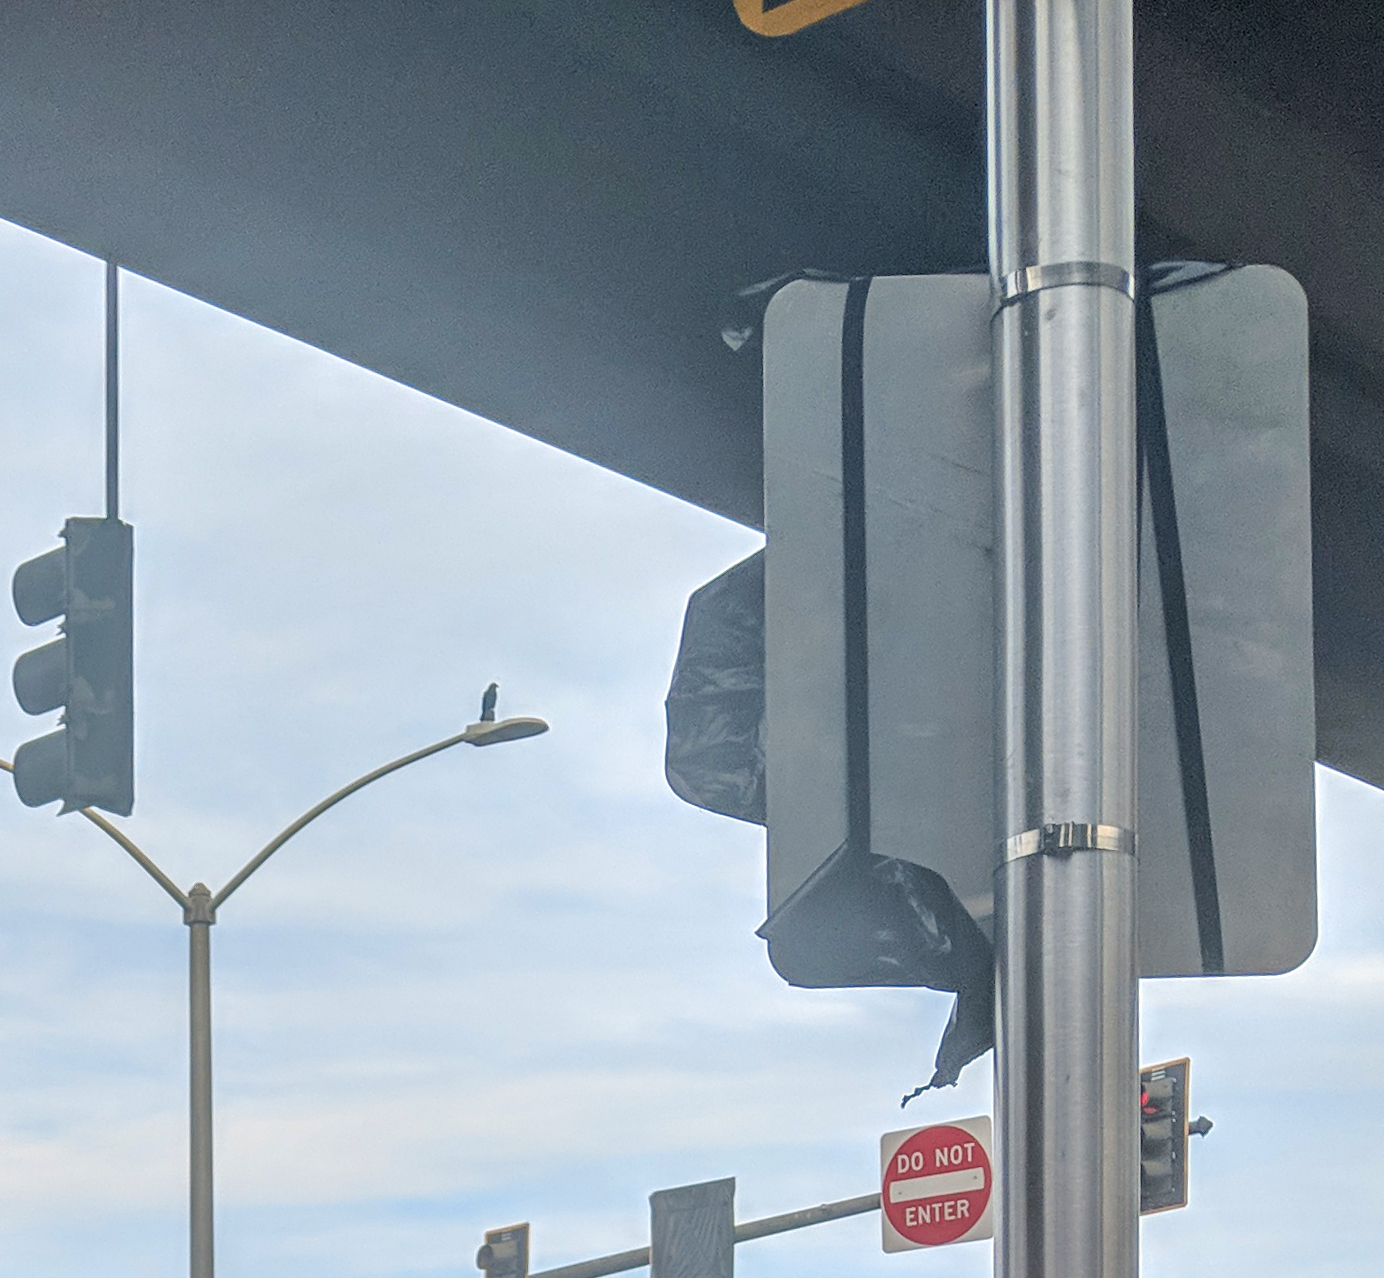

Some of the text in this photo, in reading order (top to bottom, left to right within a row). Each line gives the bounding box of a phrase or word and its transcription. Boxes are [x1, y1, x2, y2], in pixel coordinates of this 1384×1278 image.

[897, 1142, 976, 1174] DO NOT
[905, 1199, 970, 1227] ENTER
